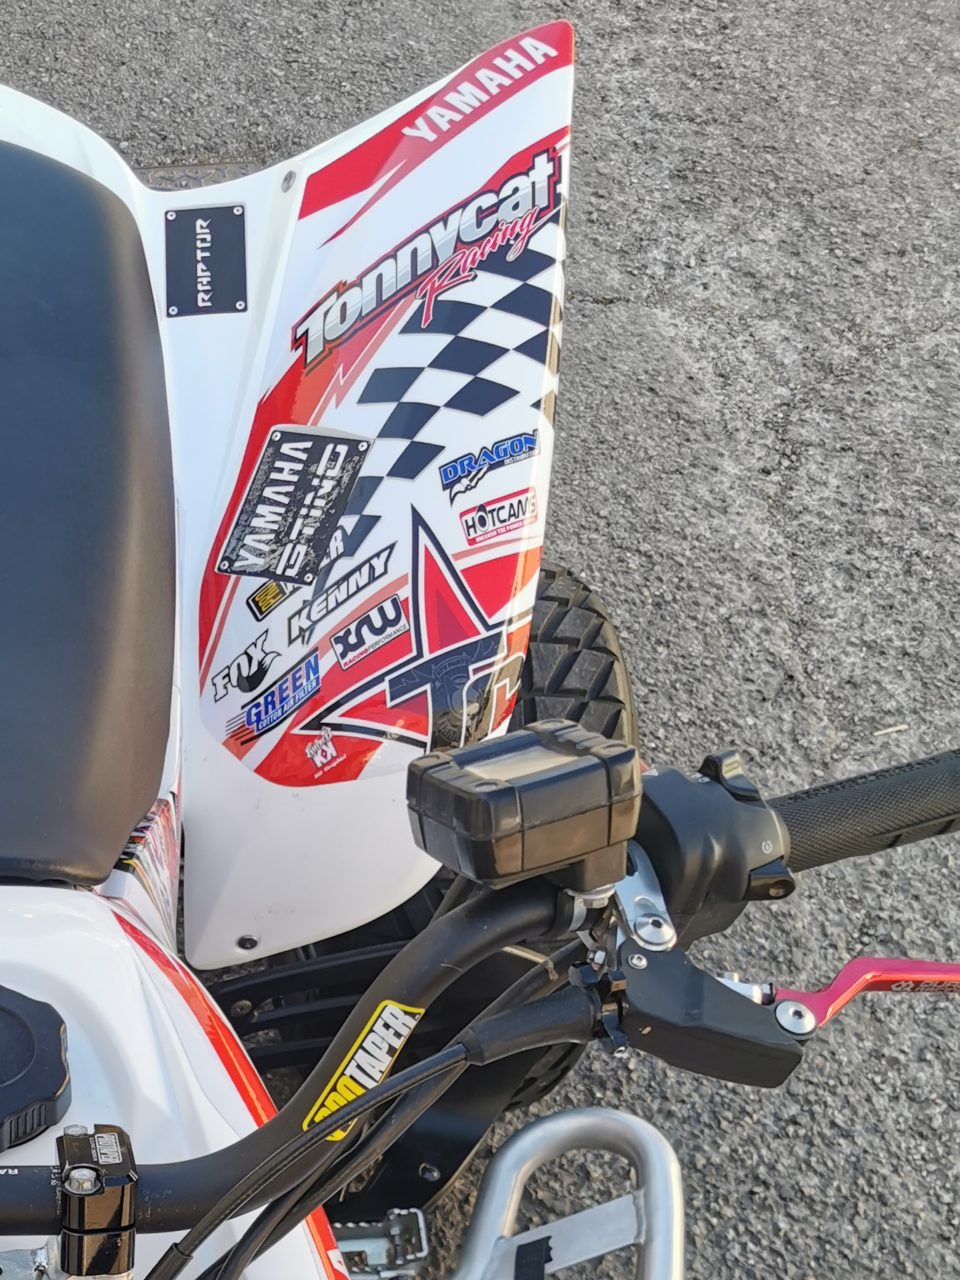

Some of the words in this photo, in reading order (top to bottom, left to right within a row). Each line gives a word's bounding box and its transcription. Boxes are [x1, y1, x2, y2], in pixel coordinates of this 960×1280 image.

[401, 35, 559, 146] YAMAHA
[196, 218, 214, 308] RAPTOR
[295, 155, 555, 367] Tonnycat
[440, 430, 542, 486] DRAGON
[233, 441, 313, 570] YAMAHA
[290, 547, 394, 640] KENNY
[213, 630, 282, 703] FOX
[245, 653, 320, 733] GREEN
